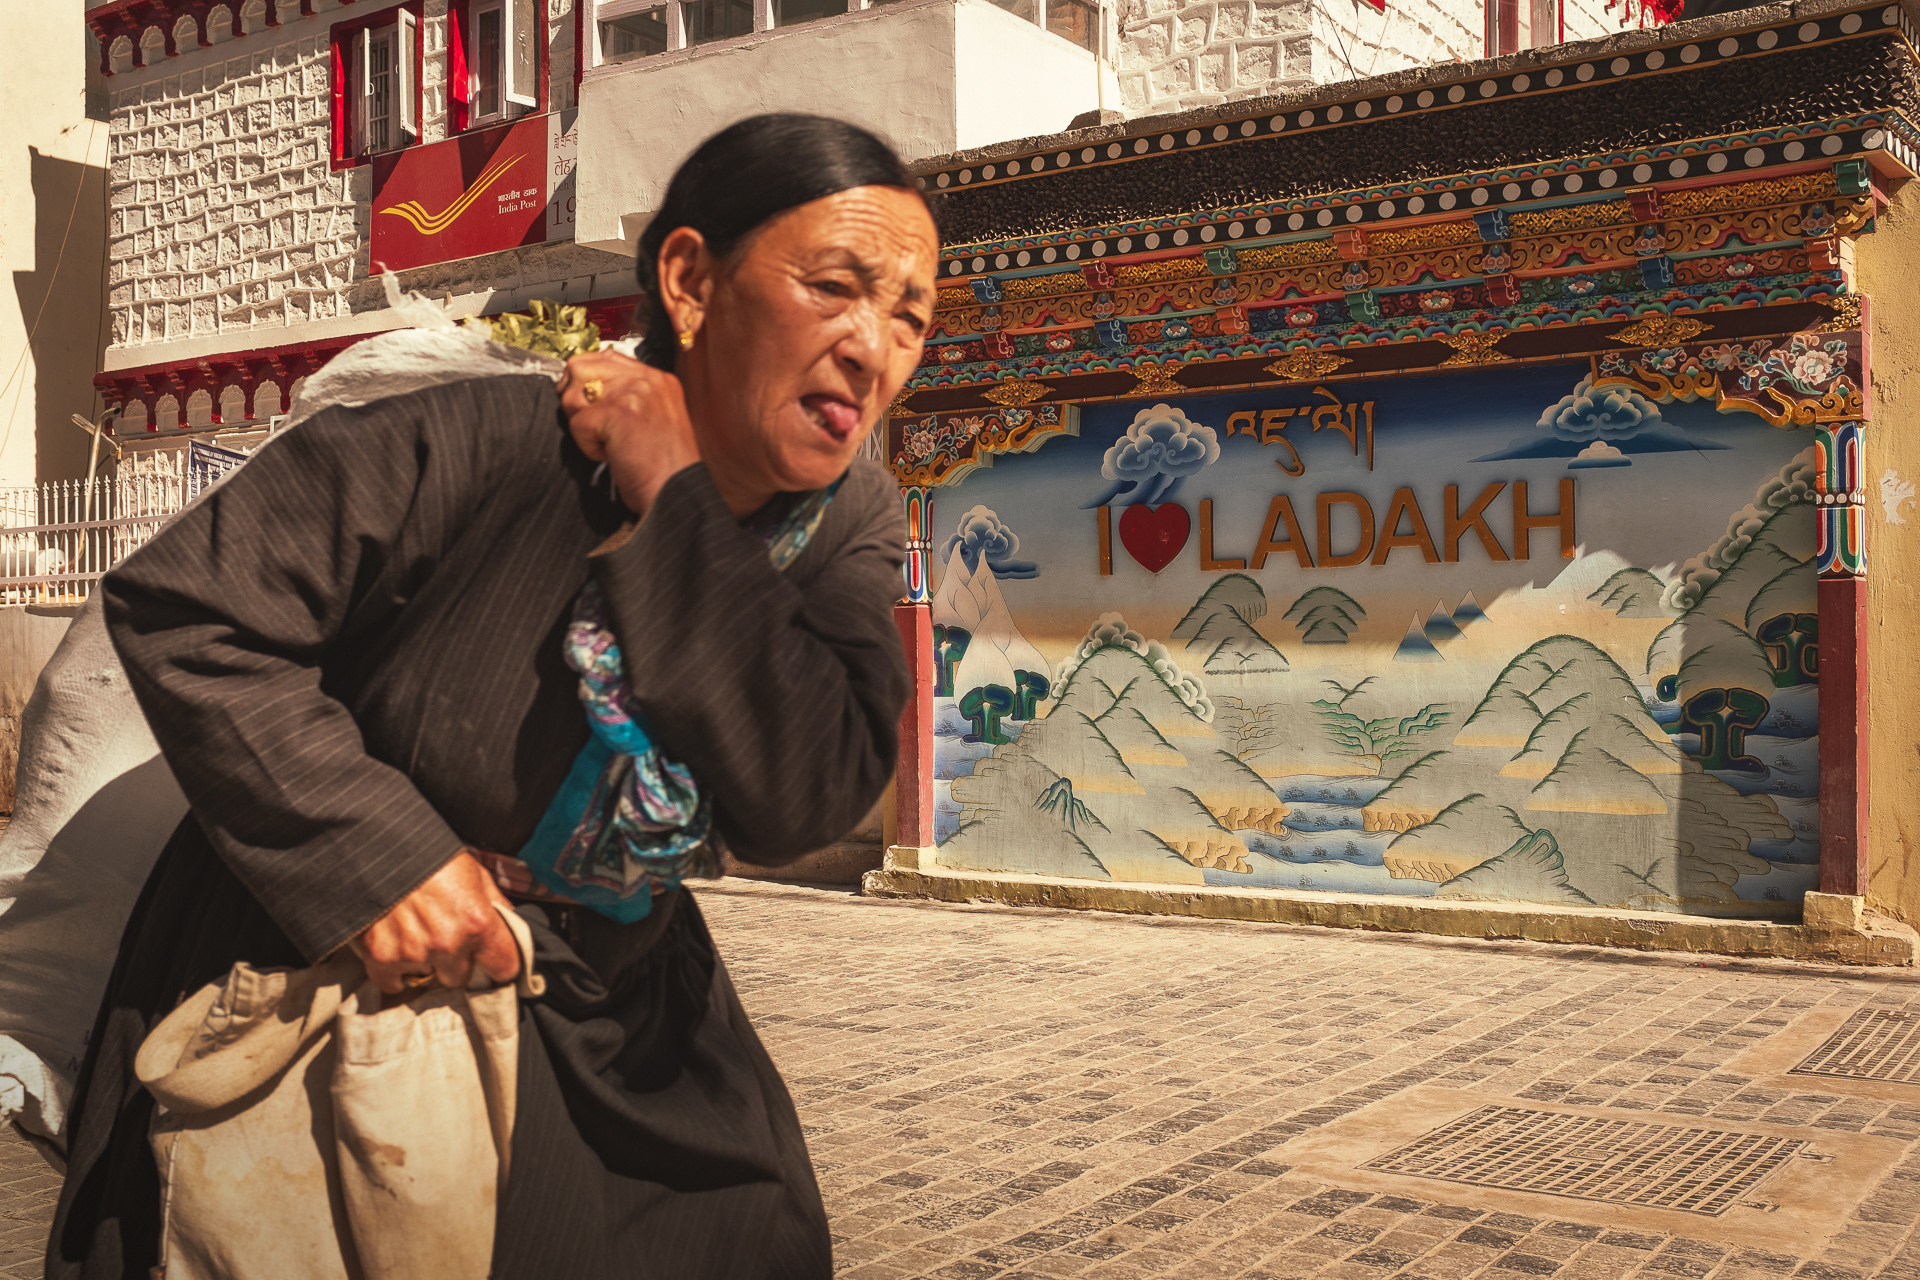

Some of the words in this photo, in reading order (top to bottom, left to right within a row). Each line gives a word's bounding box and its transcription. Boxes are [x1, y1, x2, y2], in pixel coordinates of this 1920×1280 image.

[553, 179, 570, 193] Leh
[497, 190, 520, 202] भारतीय
[523, 187, 537, 197] डाक
[498, 202, 518, 214] India
[520, 199, 537, 210] Post
[1098, 506, 1113, 576] I
[1200, 478, 1577, 571] LADAKH
